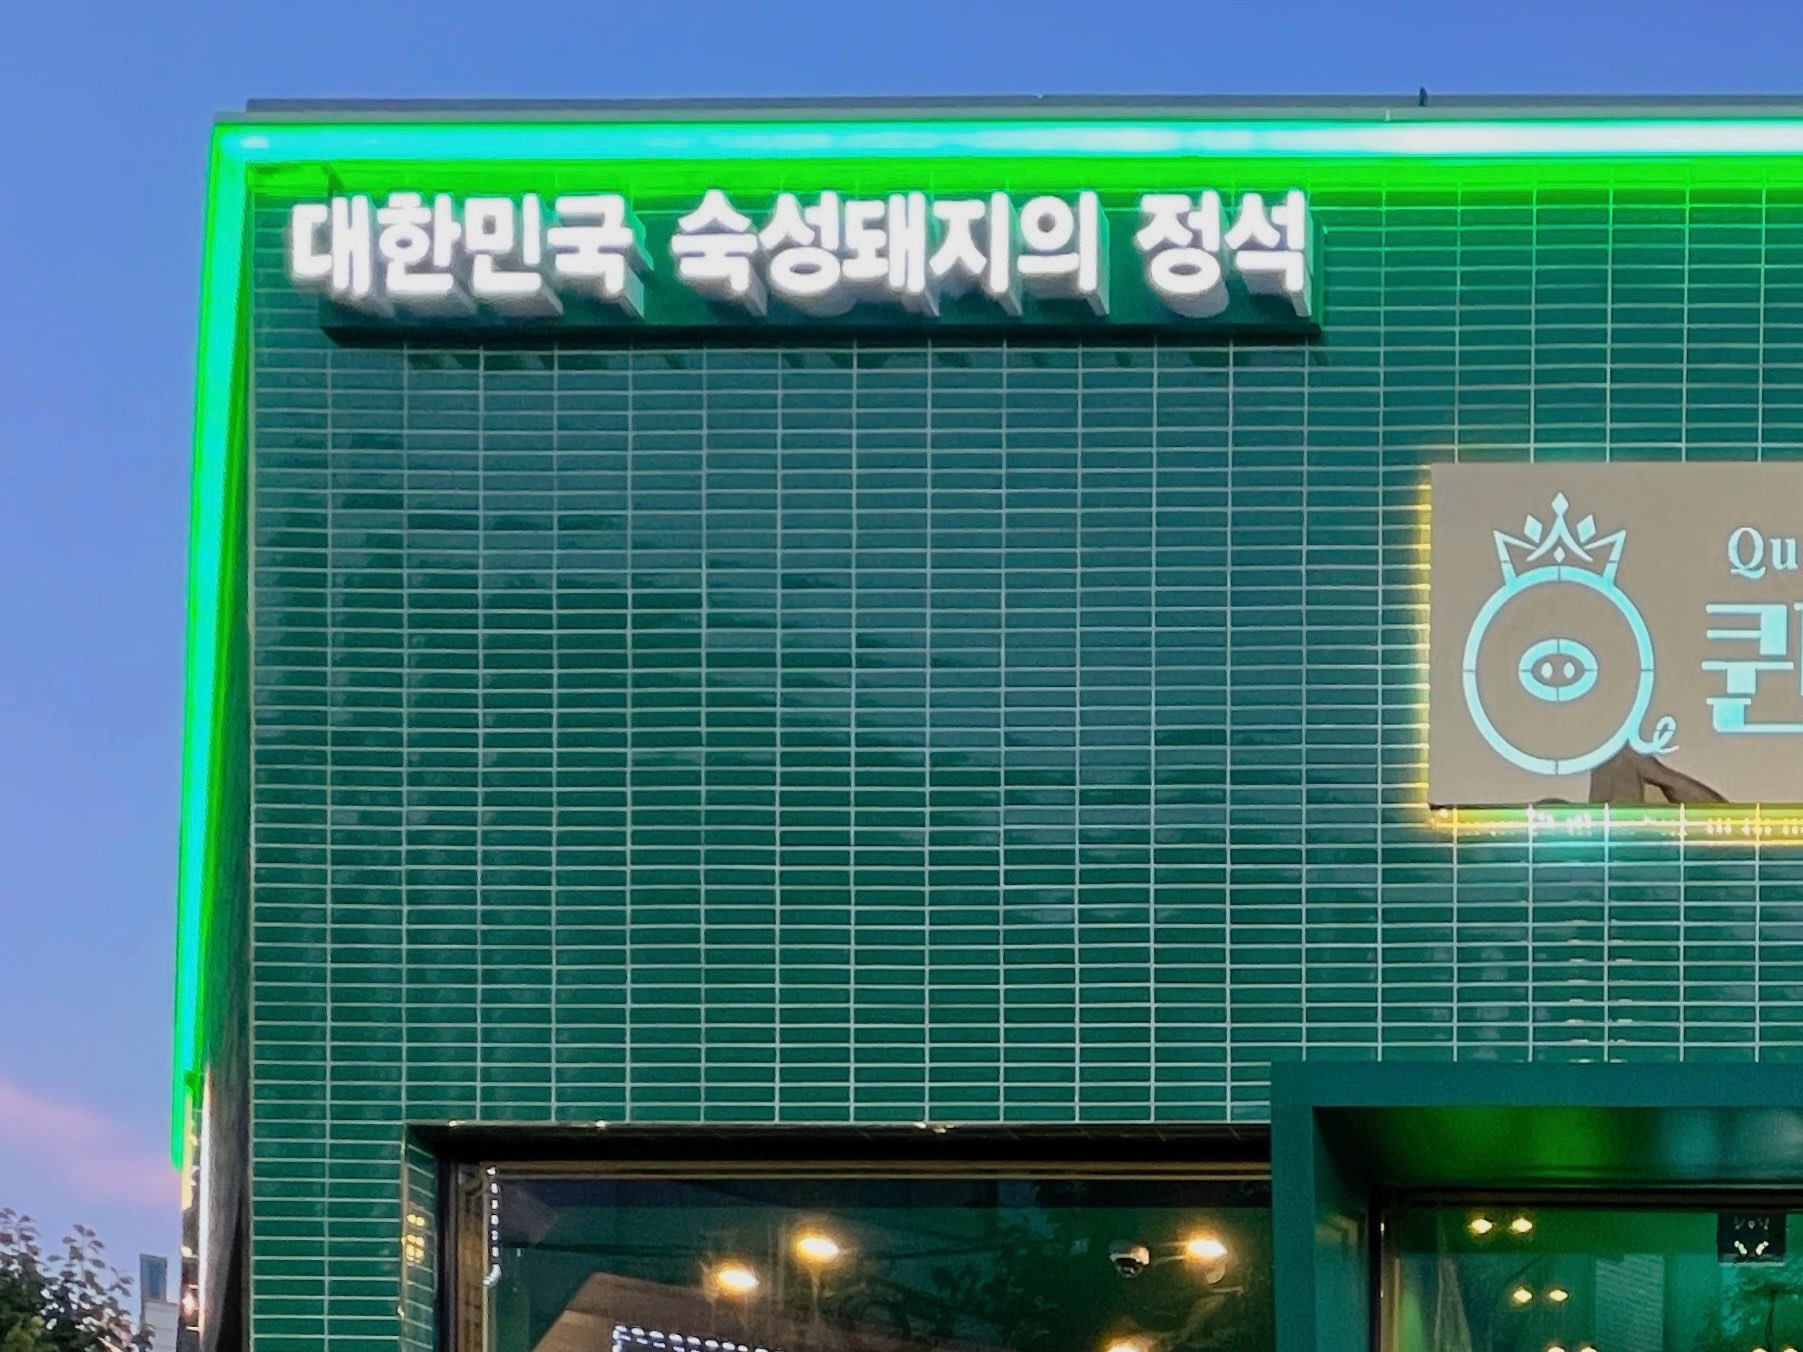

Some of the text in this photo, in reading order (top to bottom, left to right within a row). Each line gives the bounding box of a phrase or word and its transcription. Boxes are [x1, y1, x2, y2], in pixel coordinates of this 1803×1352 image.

[288, 188, 1312, 312] 대한민국 숙성돼지의 정석
